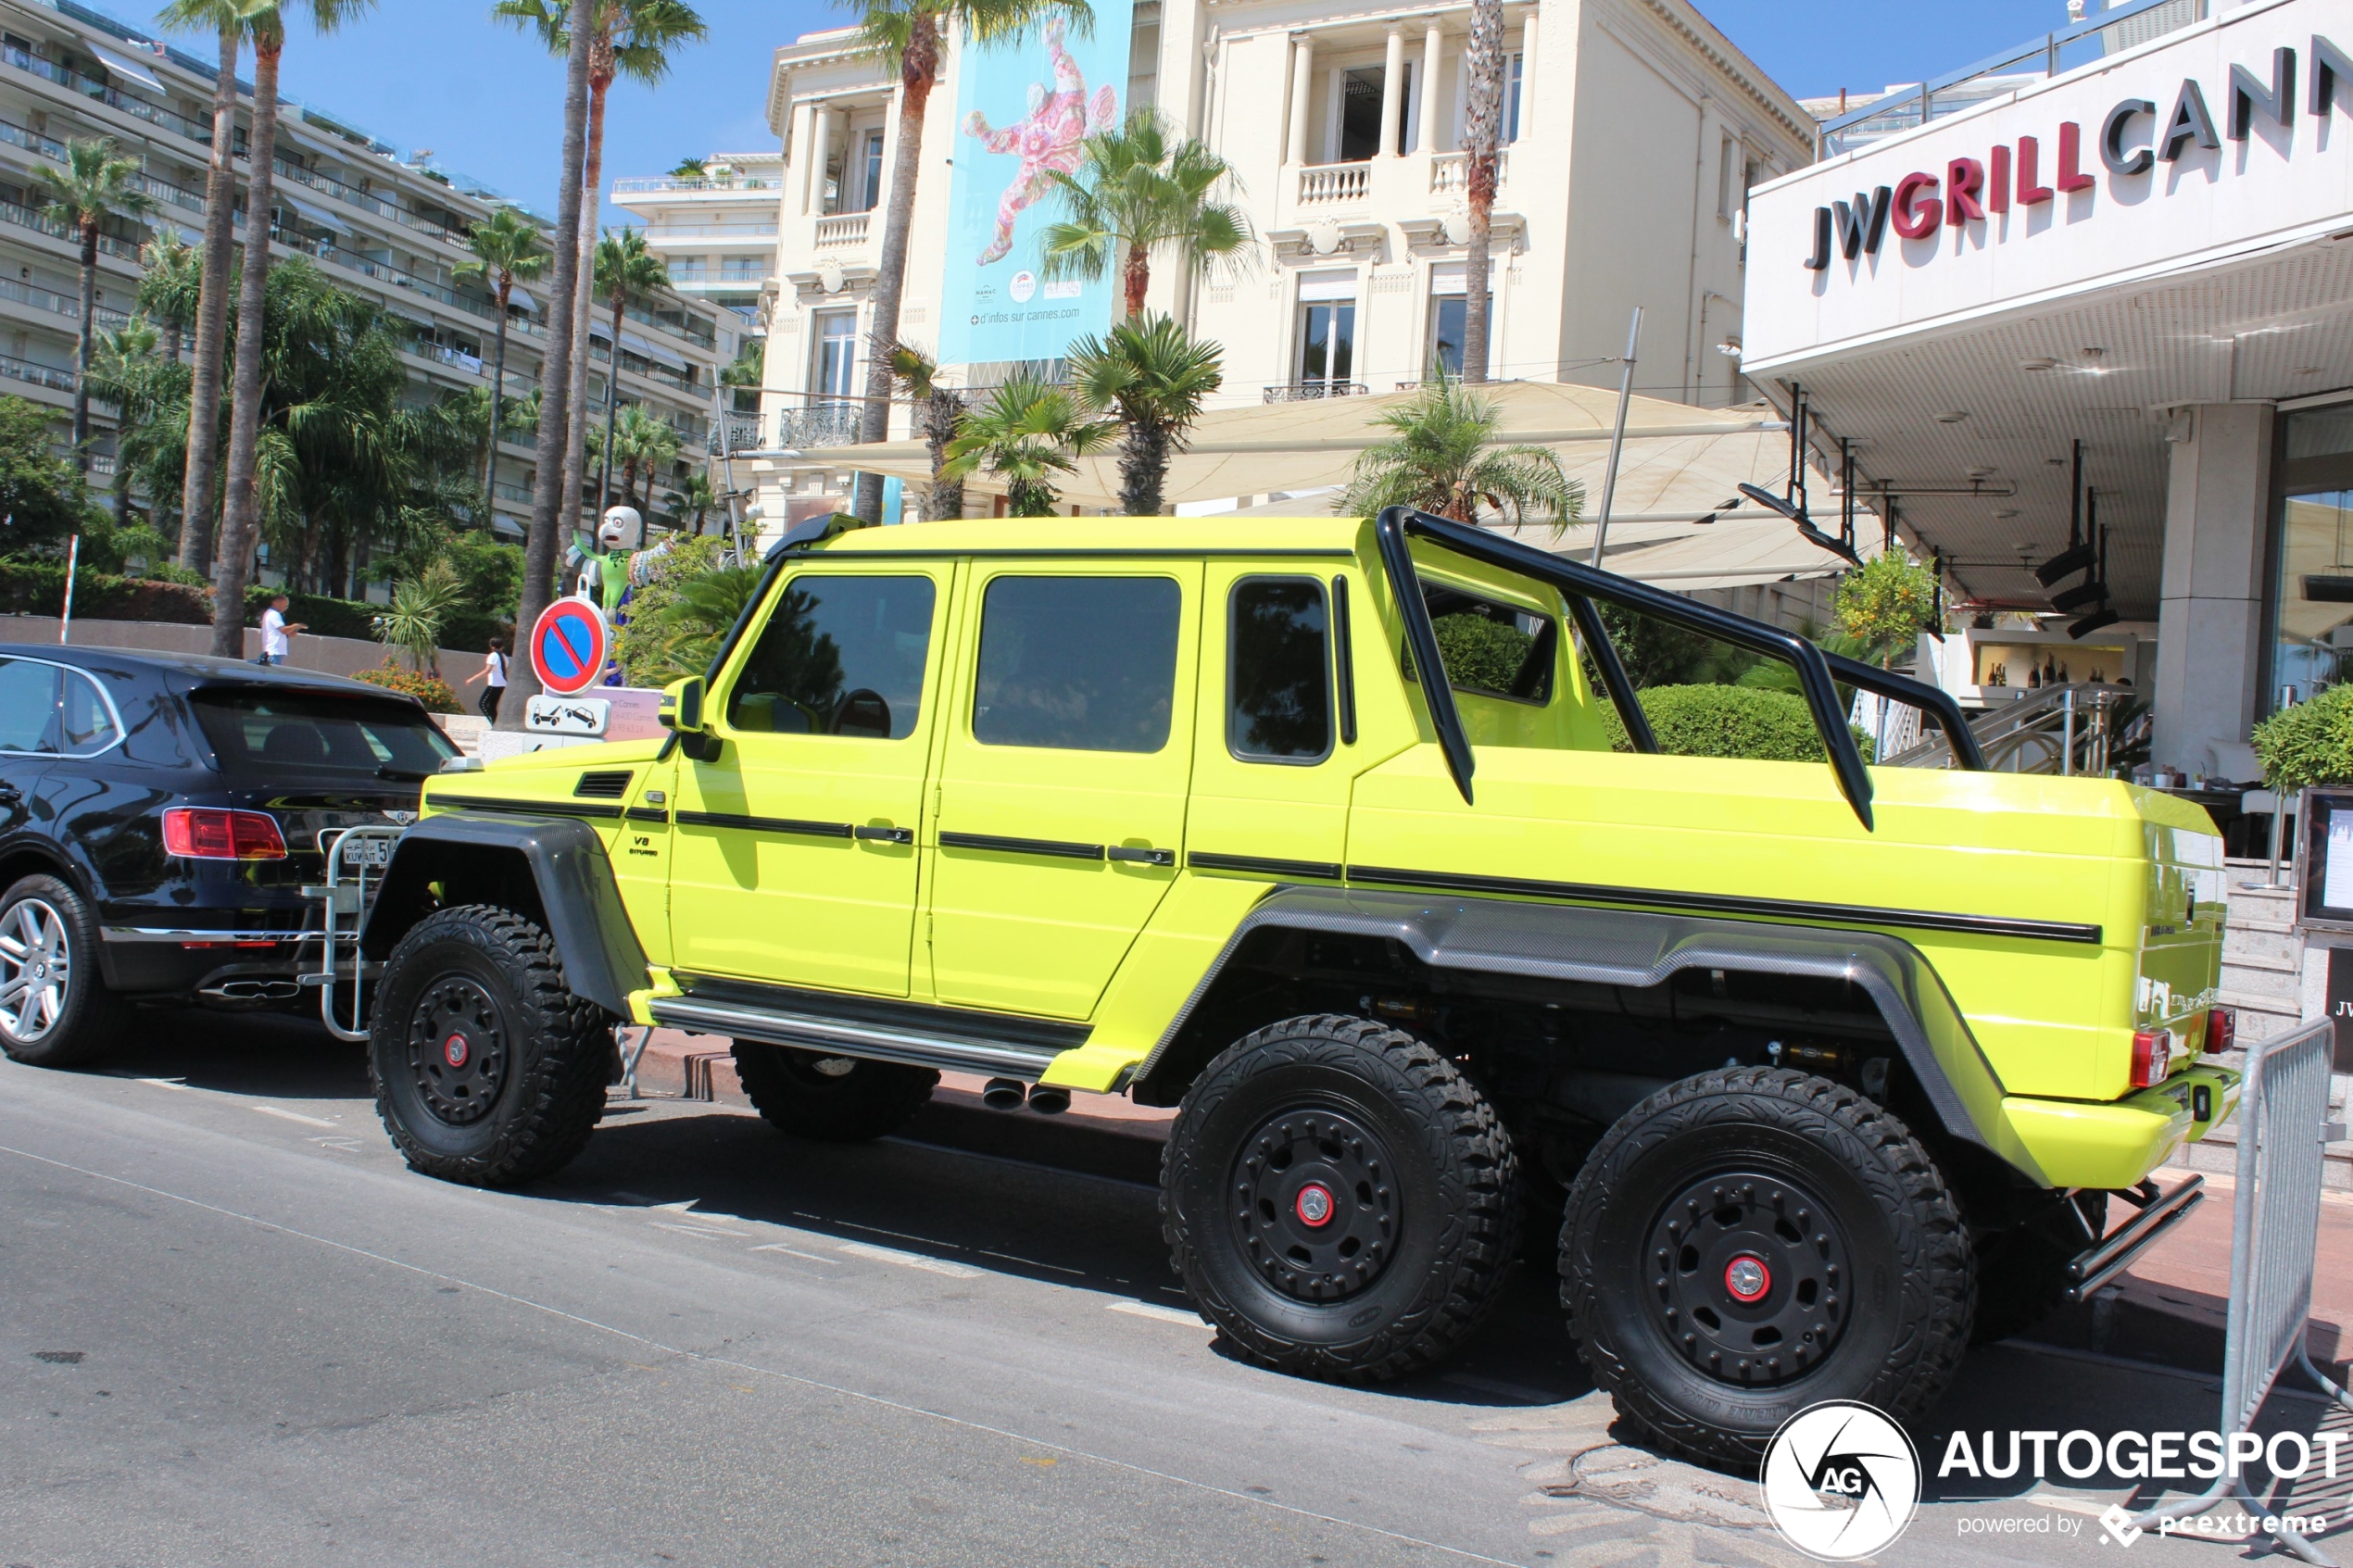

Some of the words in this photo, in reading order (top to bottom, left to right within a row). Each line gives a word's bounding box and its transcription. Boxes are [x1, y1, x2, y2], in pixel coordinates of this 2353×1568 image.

[980, 311, 1008, 324] d'infos
[1011, 313, 1026, 322] sur
[1026, 308, 1079, 320] cannes.com
[618, 699, 640, 709] Cannes
[635, 836, 649, 847] V8
